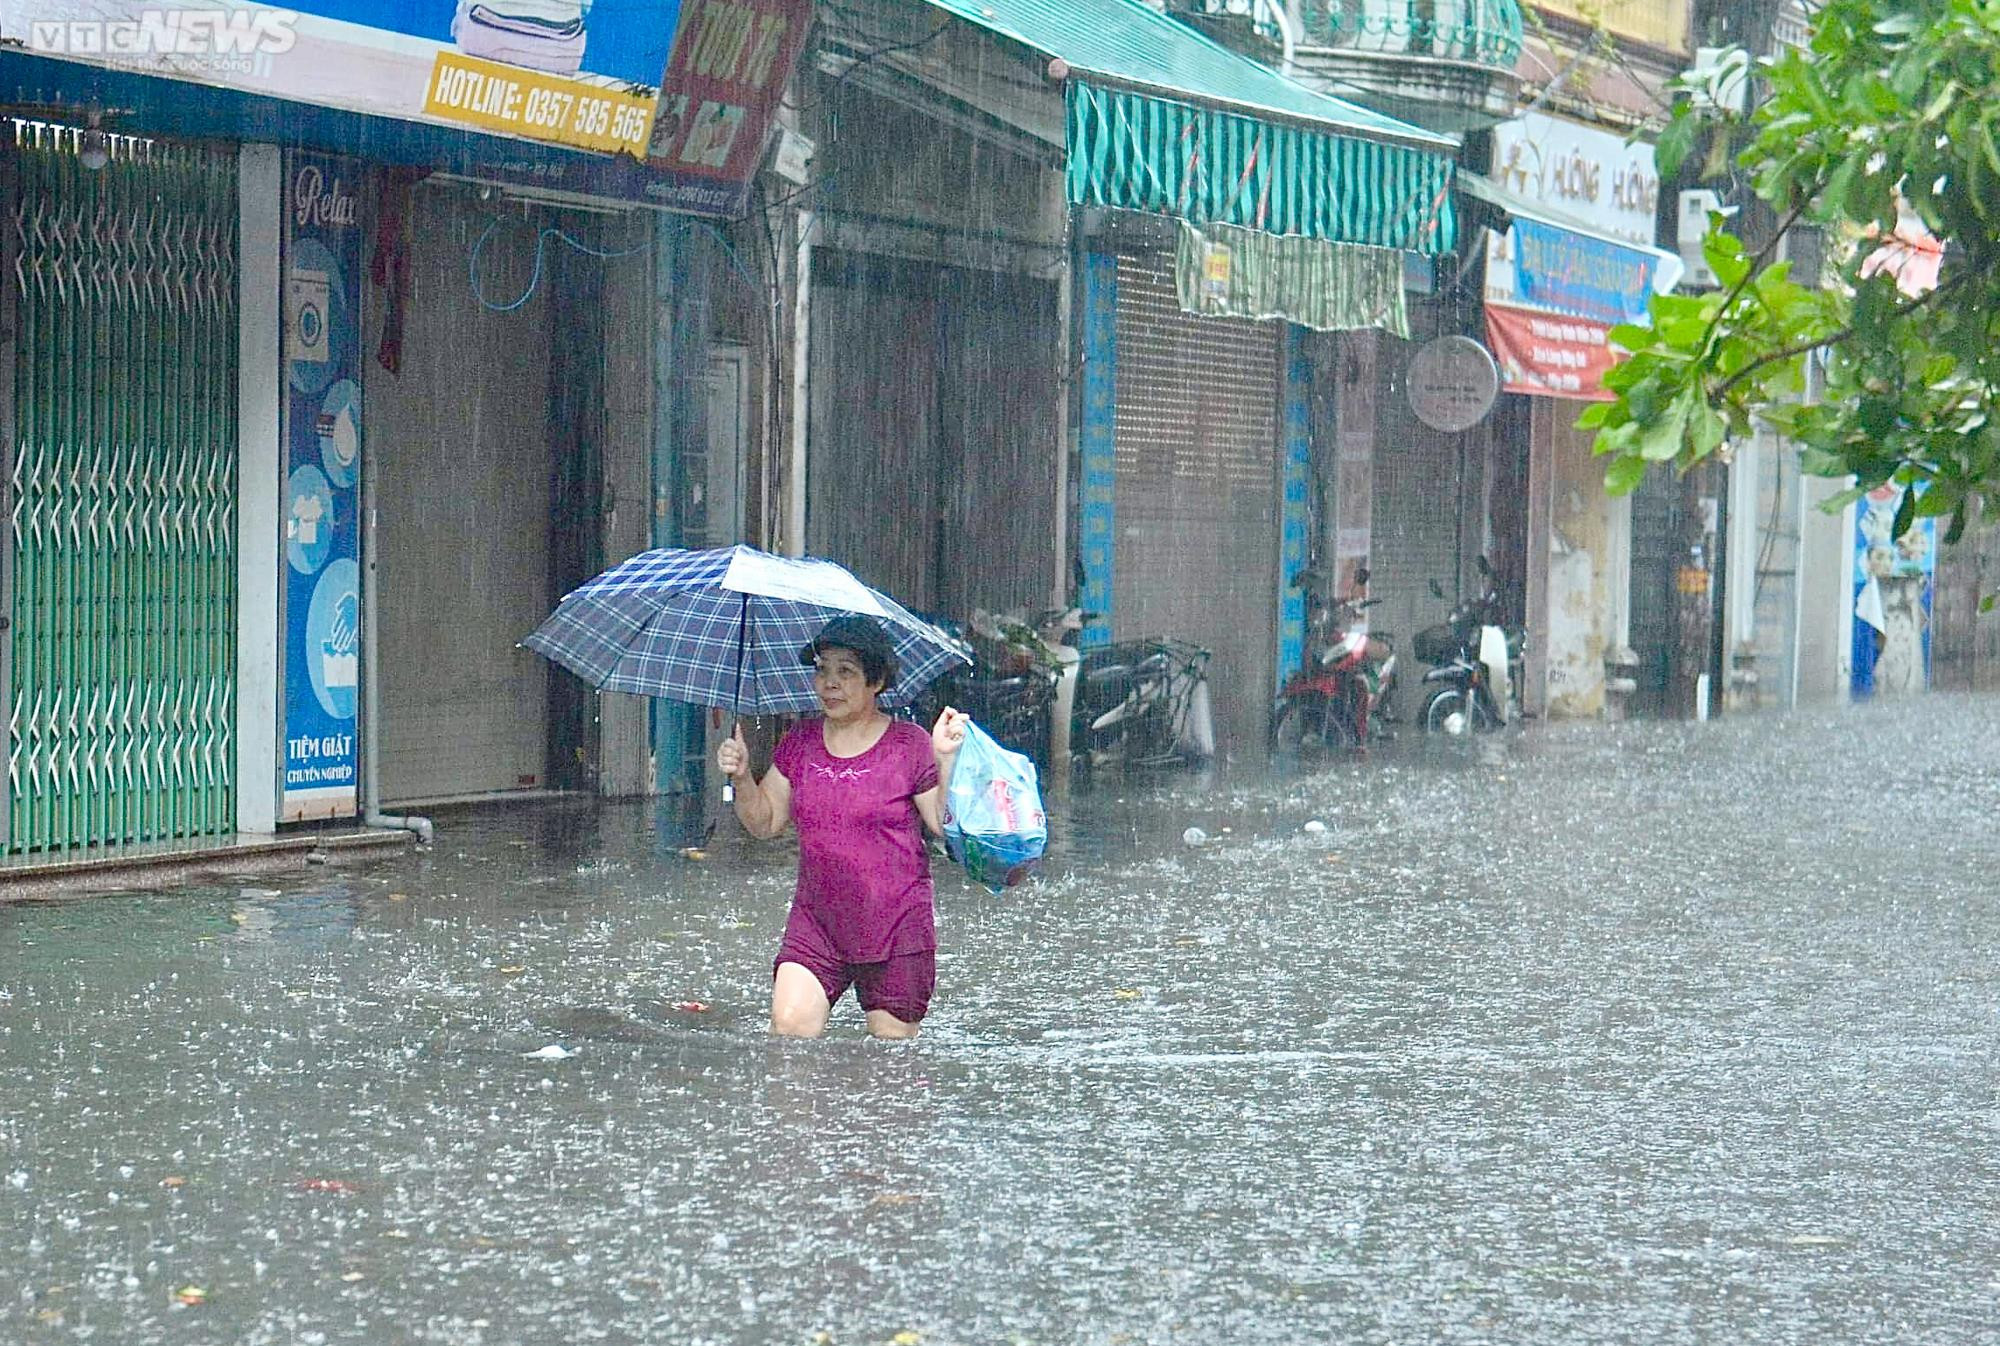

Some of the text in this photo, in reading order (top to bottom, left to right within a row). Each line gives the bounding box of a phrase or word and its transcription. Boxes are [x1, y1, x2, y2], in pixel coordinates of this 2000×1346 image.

[434, 65, 647, 143] HOTLINE: 0357 585 565
[288, 732, 352, 764] TIỆM GIẶT
[287, 763, 352, 783] CHUYÊN NGHIỆP
